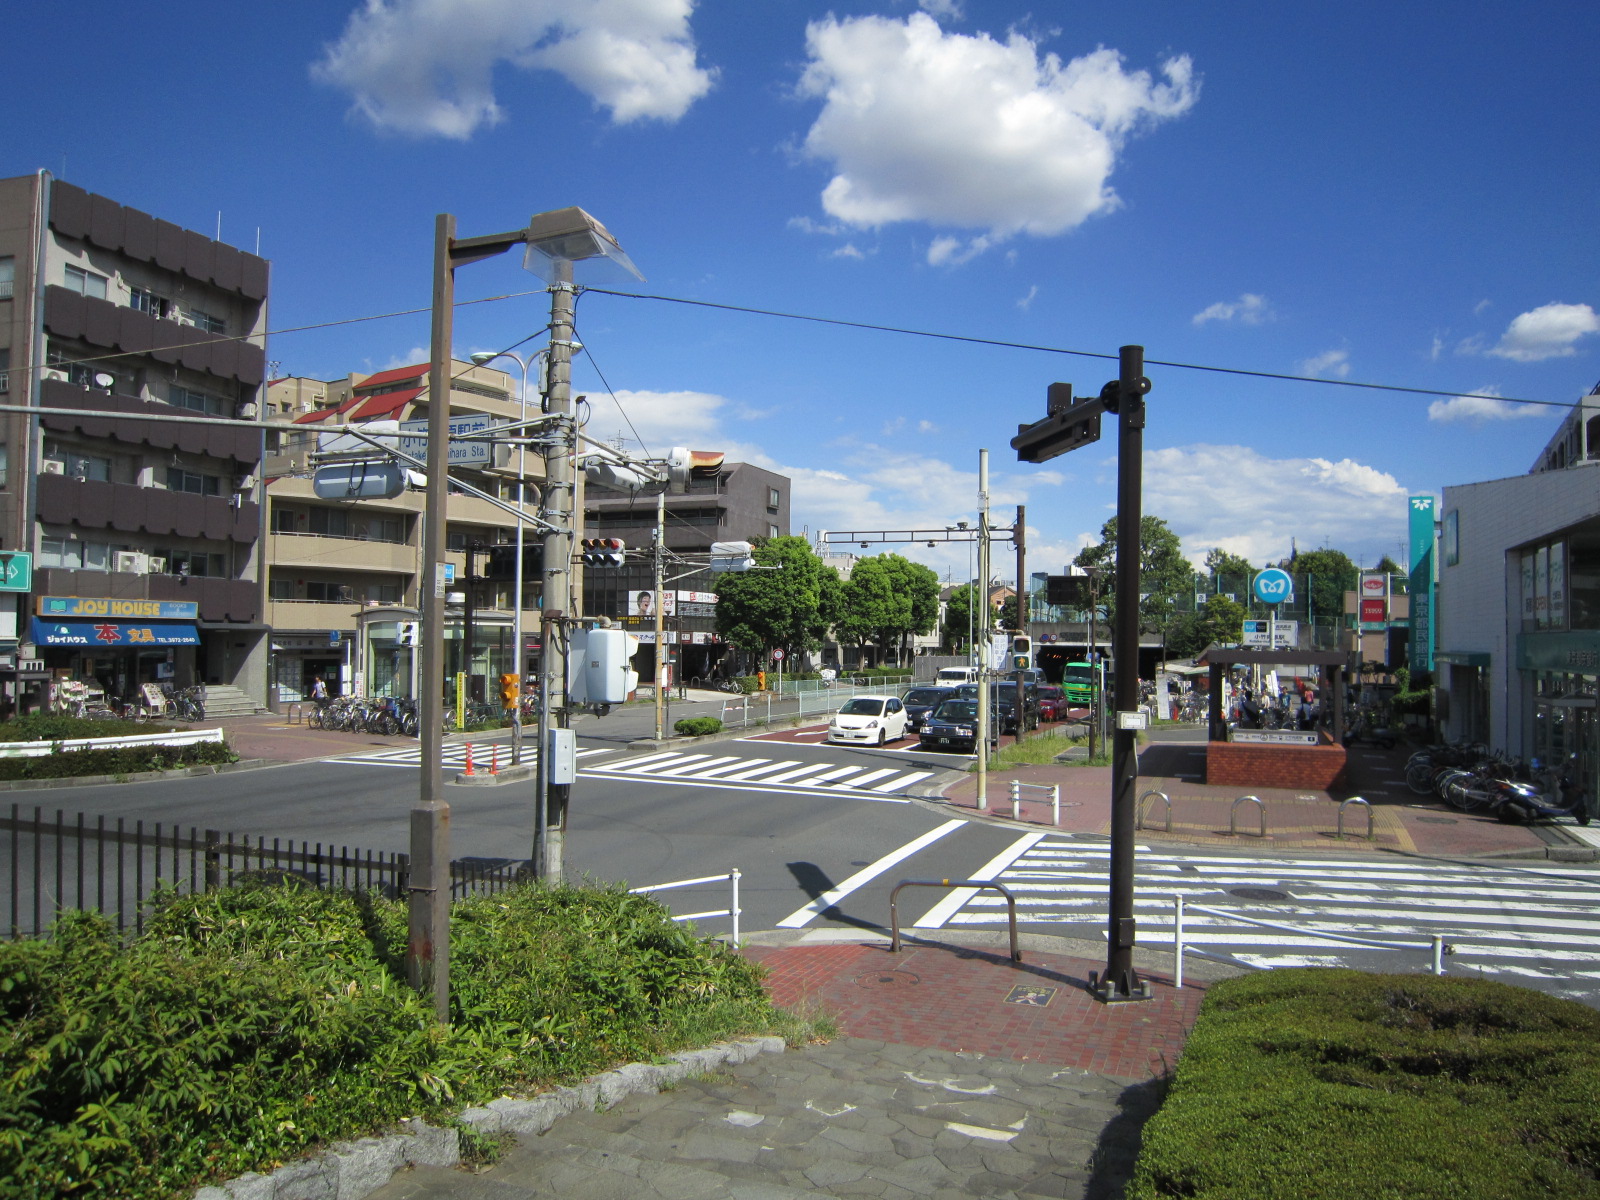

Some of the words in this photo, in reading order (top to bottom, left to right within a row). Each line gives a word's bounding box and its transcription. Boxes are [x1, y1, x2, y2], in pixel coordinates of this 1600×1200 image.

[471, 446, 486, 457] Sta.
[73, 600, 109, 615] JOY
[111, 601, 161, 616] HOUSE
[94, 623, 122, 644] 本
[127, 628, 156, 643] 文具
[1415, 592, 1429, 668] 東京都民銀行
[47, 635, 88, 644] ジョイハウス
